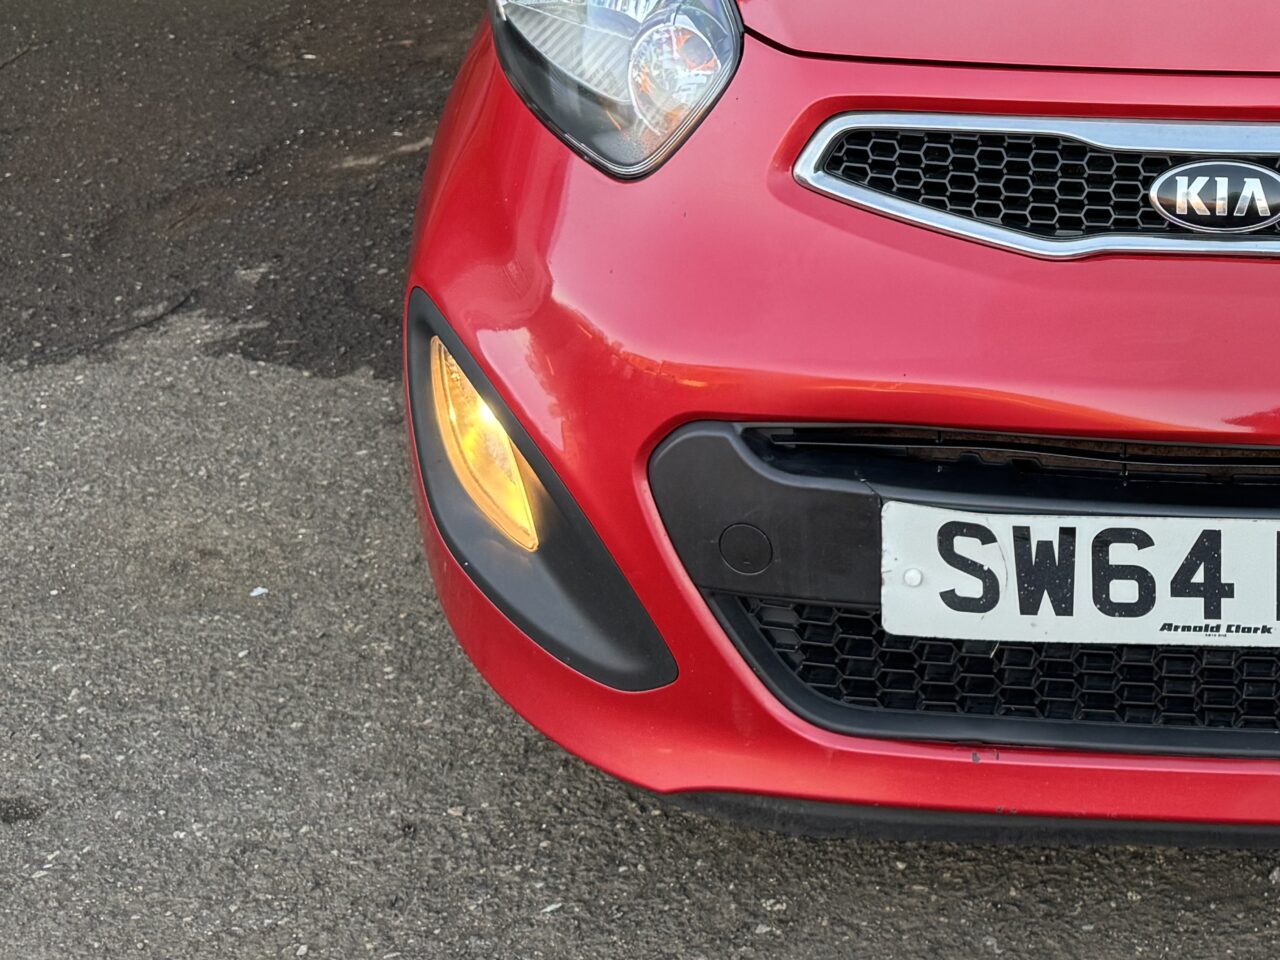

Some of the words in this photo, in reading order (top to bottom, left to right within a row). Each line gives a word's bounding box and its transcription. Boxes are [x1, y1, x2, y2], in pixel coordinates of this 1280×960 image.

[1175, 176, 1271, 217] KIA
[937, 520, 1235, 620] SW64
[1160, 622, 1222, 633] Arnold
[1226, 624, 1273, 635] Clark
